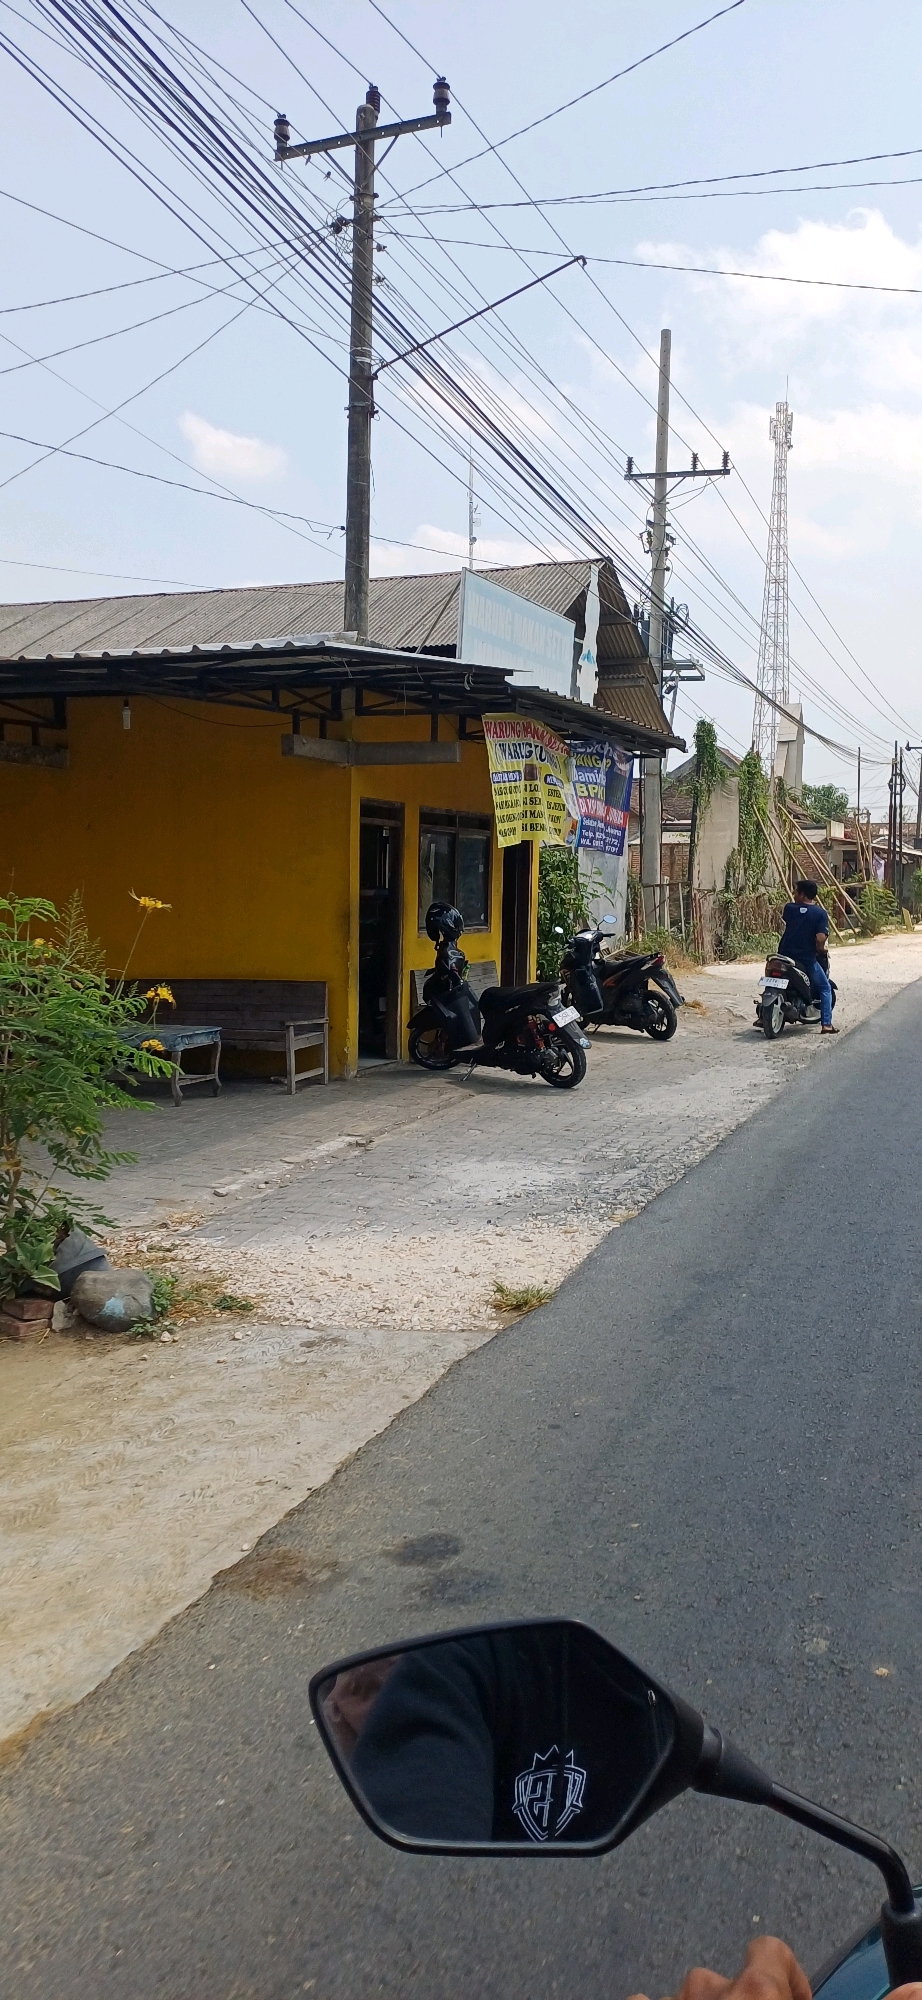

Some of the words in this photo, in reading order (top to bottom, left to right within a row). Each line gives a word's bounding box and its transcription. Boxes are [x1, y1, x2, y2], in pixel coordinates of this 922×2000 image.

[468, 588, 513, 642] WARUNG
[514, 610, 546, 656] MAKAN
[484, 720, 521, 739] WARUNG
